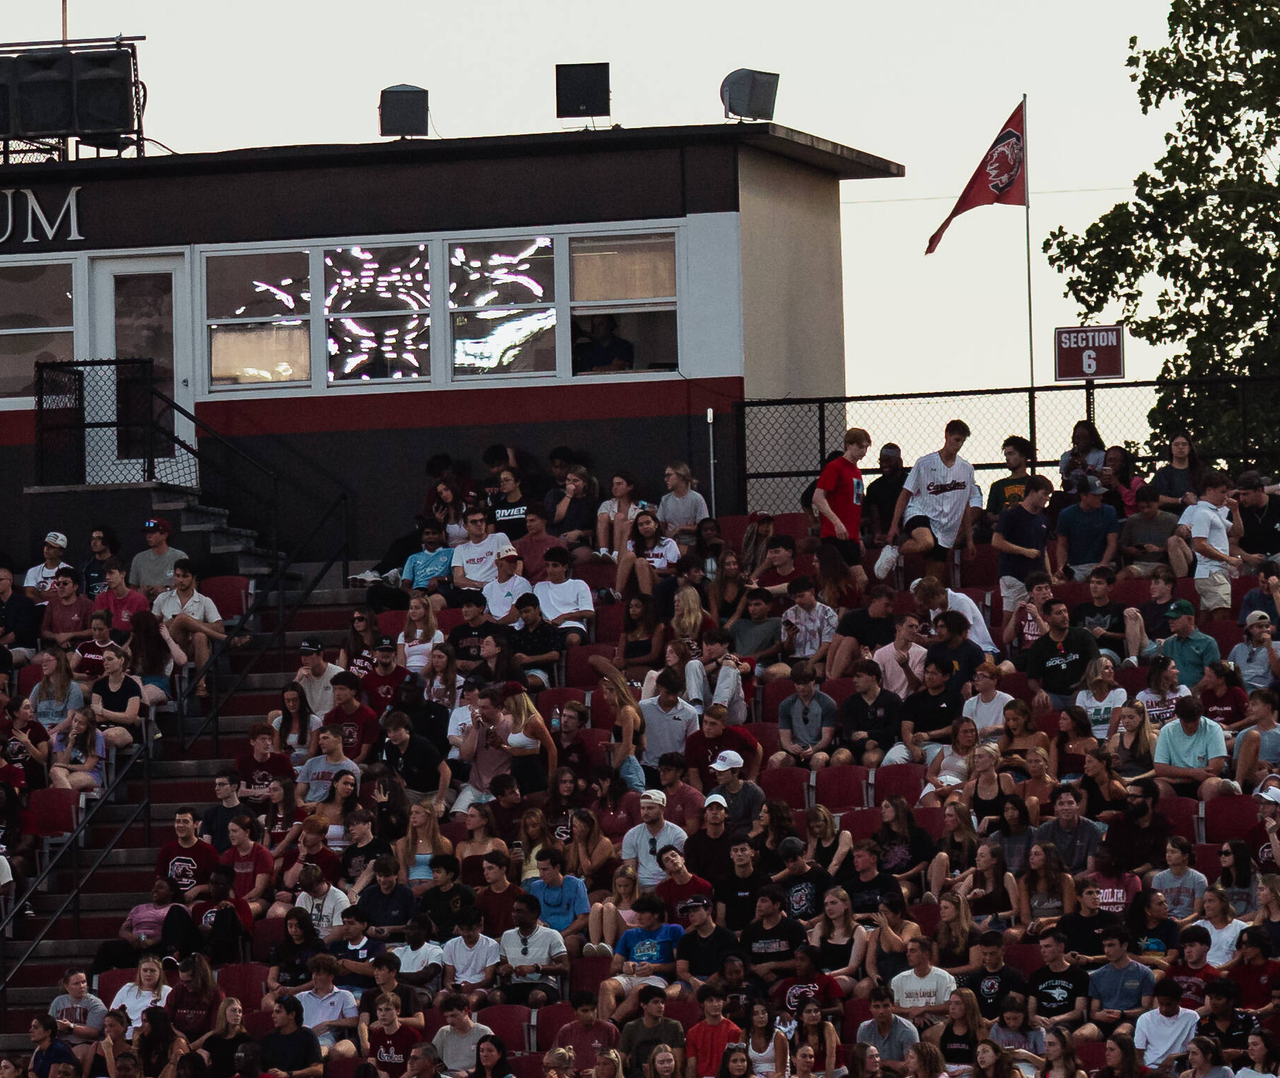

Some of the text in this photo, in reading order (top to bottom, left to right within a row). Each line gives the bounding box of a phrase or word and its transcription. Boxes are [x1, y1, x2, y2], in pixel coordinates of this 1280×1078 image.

[1060, 330, 1117, 349] SECTION
[1082, 349, 1097, 375] 6
[926, 479, 967, 497] Carolina
